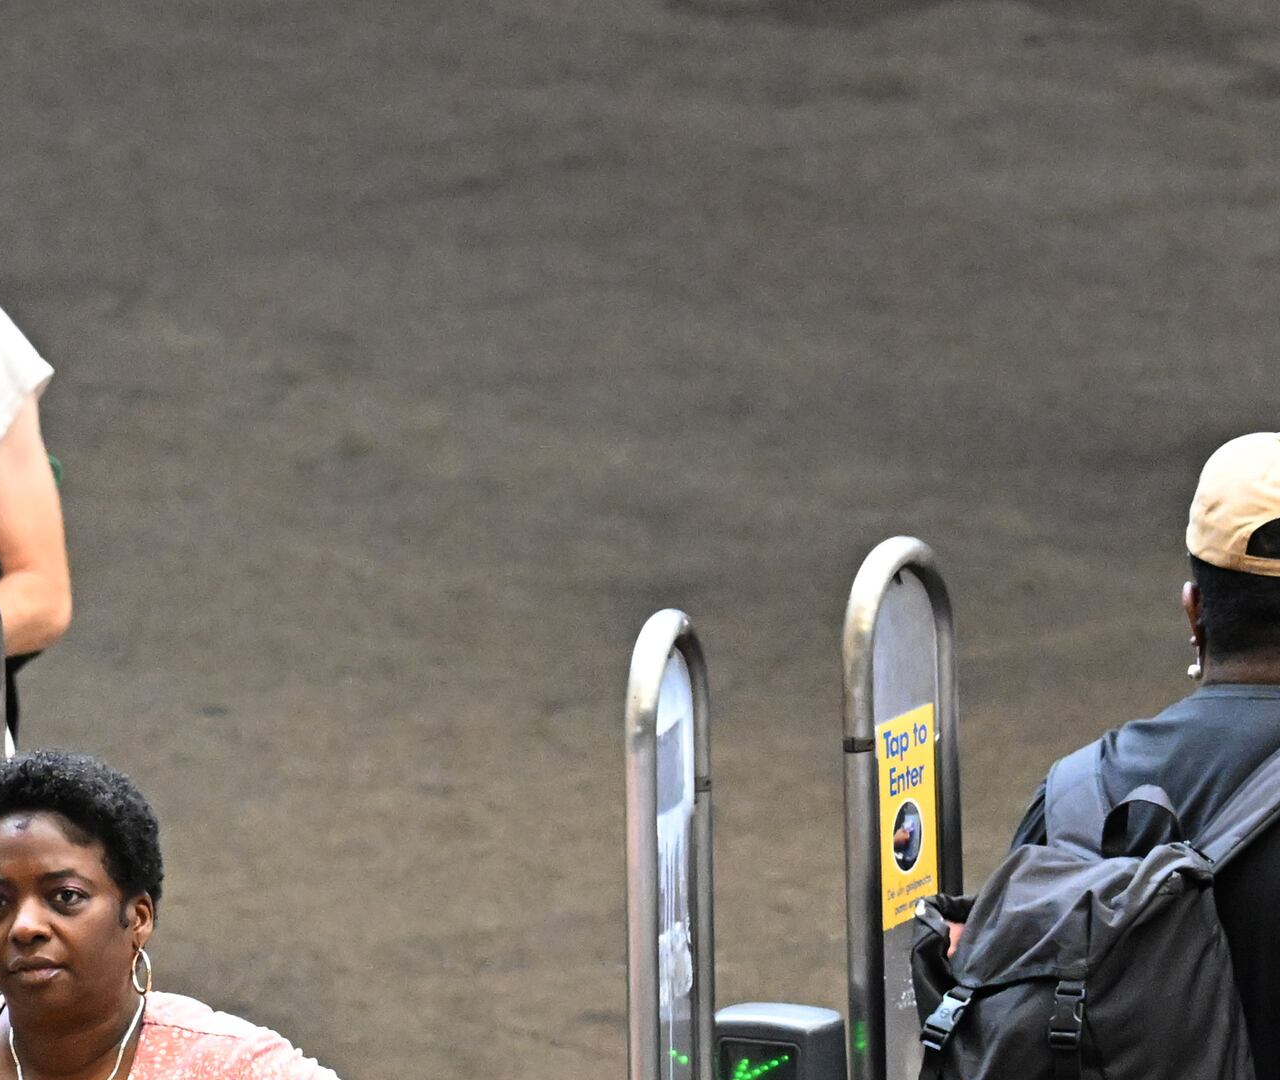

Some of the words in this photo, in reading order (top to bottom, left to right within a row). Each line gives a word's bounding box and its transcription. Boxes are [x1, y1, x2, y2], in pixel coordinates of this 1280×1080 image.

[883, 729, 909, 761] Tap
[913, 722, 927, 747] to
[889, 764, 925, 797] Enter
